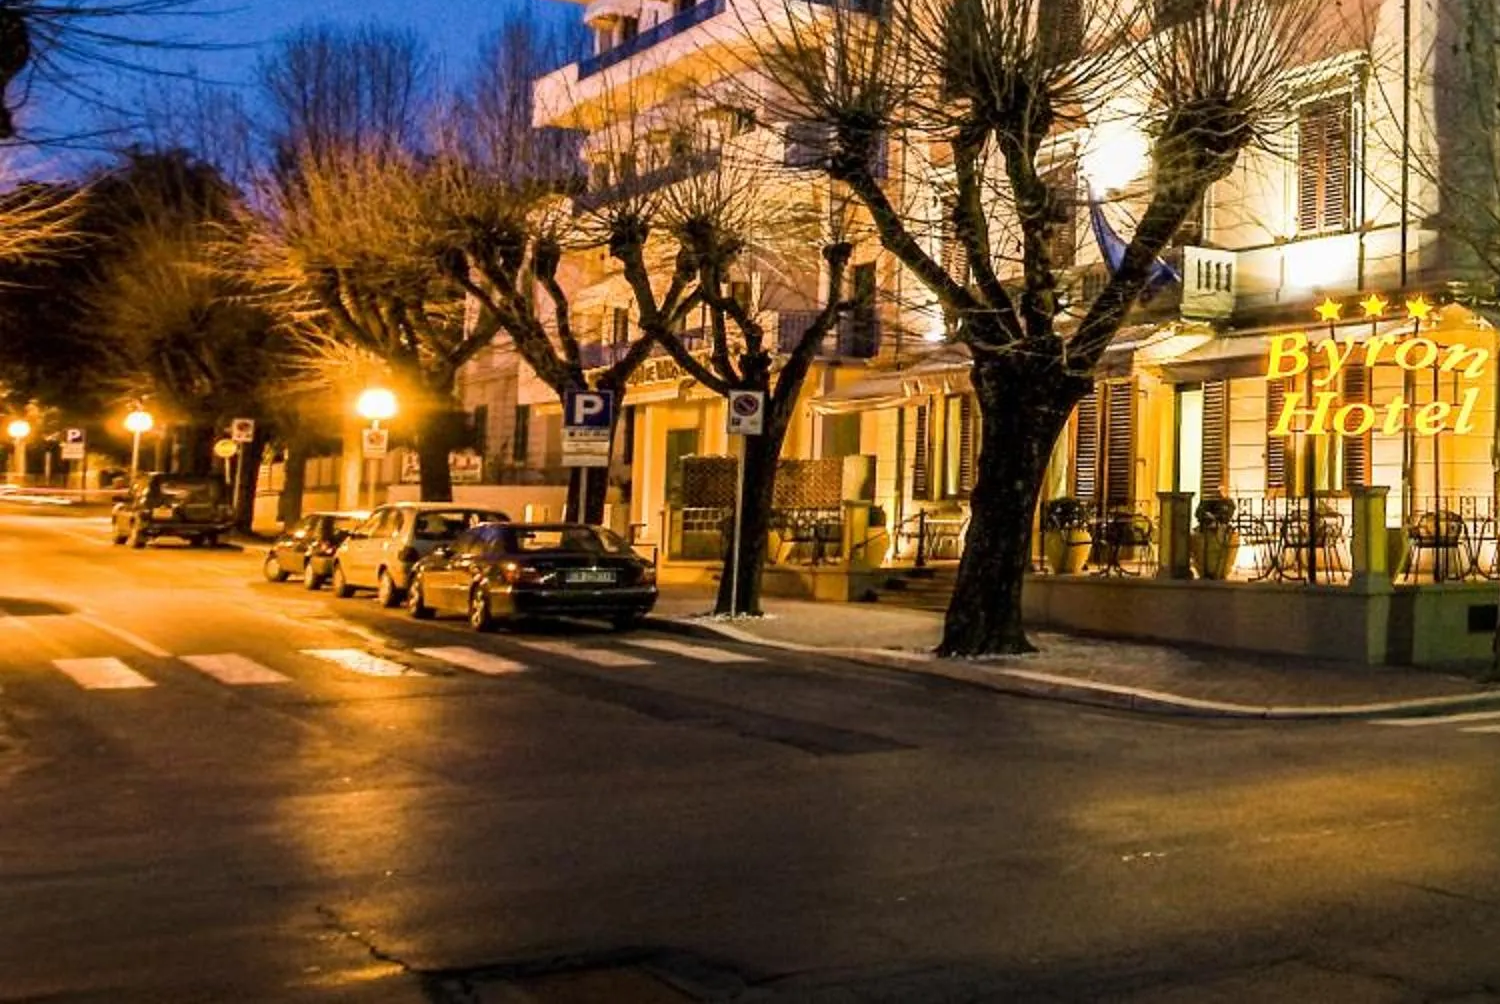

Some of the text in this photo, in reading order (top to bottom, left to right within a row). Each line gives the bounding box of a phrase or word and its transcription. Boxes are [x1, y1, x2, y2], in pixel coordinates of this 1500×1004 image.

[1264, 331, 1490, 387] Byron
[574, 394, 604, 424] P
[1267, 387, 1481, 436] Hotel
[66, 429, 81, 443] P
